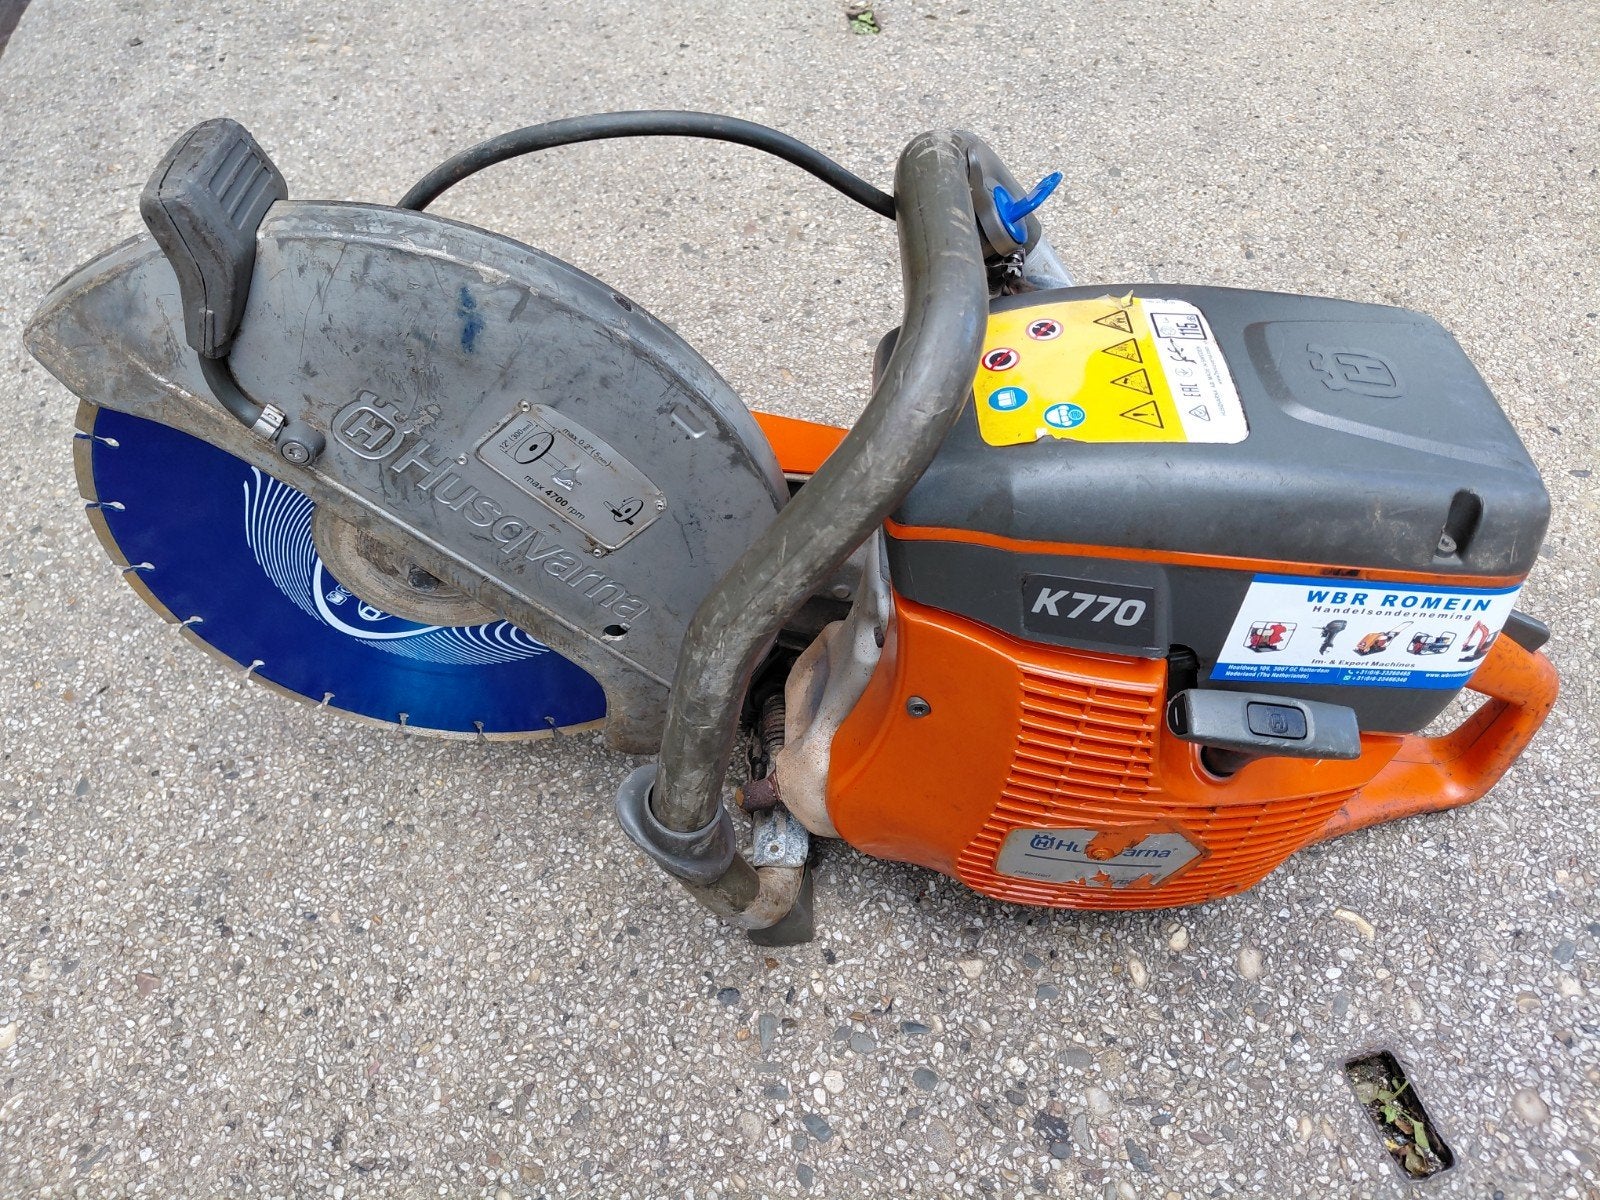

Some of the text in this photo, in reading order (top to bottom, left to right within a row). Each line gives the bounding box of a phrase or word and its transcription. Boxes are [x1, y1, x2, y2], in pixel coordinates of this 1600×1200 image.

[1176, 323, 1202, 336] 115
[562, 428, 577, 441] max
[523, 475, 586, 521] max 4700 rpm
[390, 441, 651, 621] Husqvarna
[1306, 590, 1492, 612] WBR ROMEIN
[1312, 605, 1473, 621] Handelsonderneming
[1225, 670, 1256, 678] Nederland
